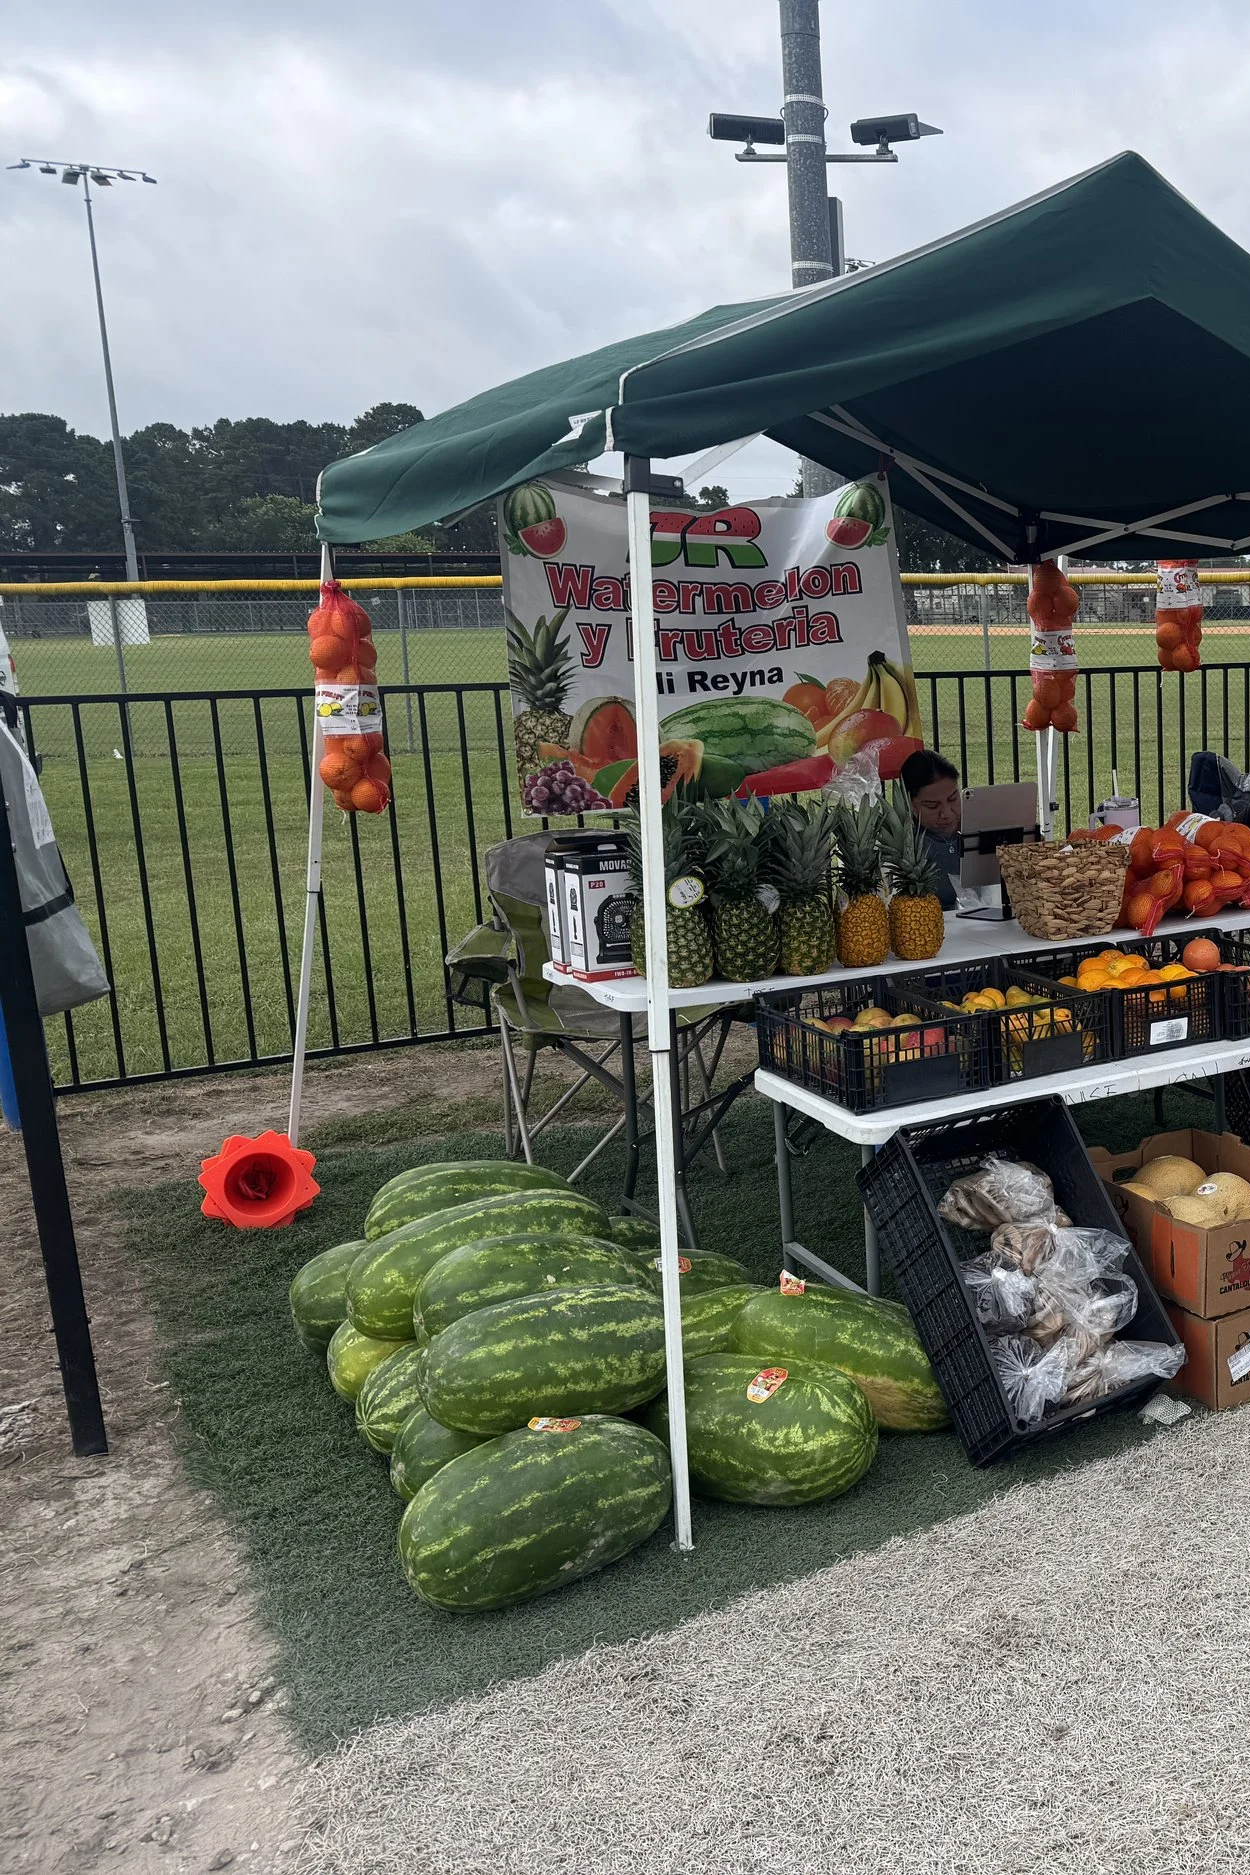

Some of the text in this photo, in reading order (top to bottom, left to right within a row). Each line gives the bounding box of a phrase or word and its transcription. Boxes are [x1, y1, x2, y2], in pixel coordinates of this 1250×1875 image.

[575, 604, 844, 668] y ruteria
[687, 666, 784, 695] Reyna
